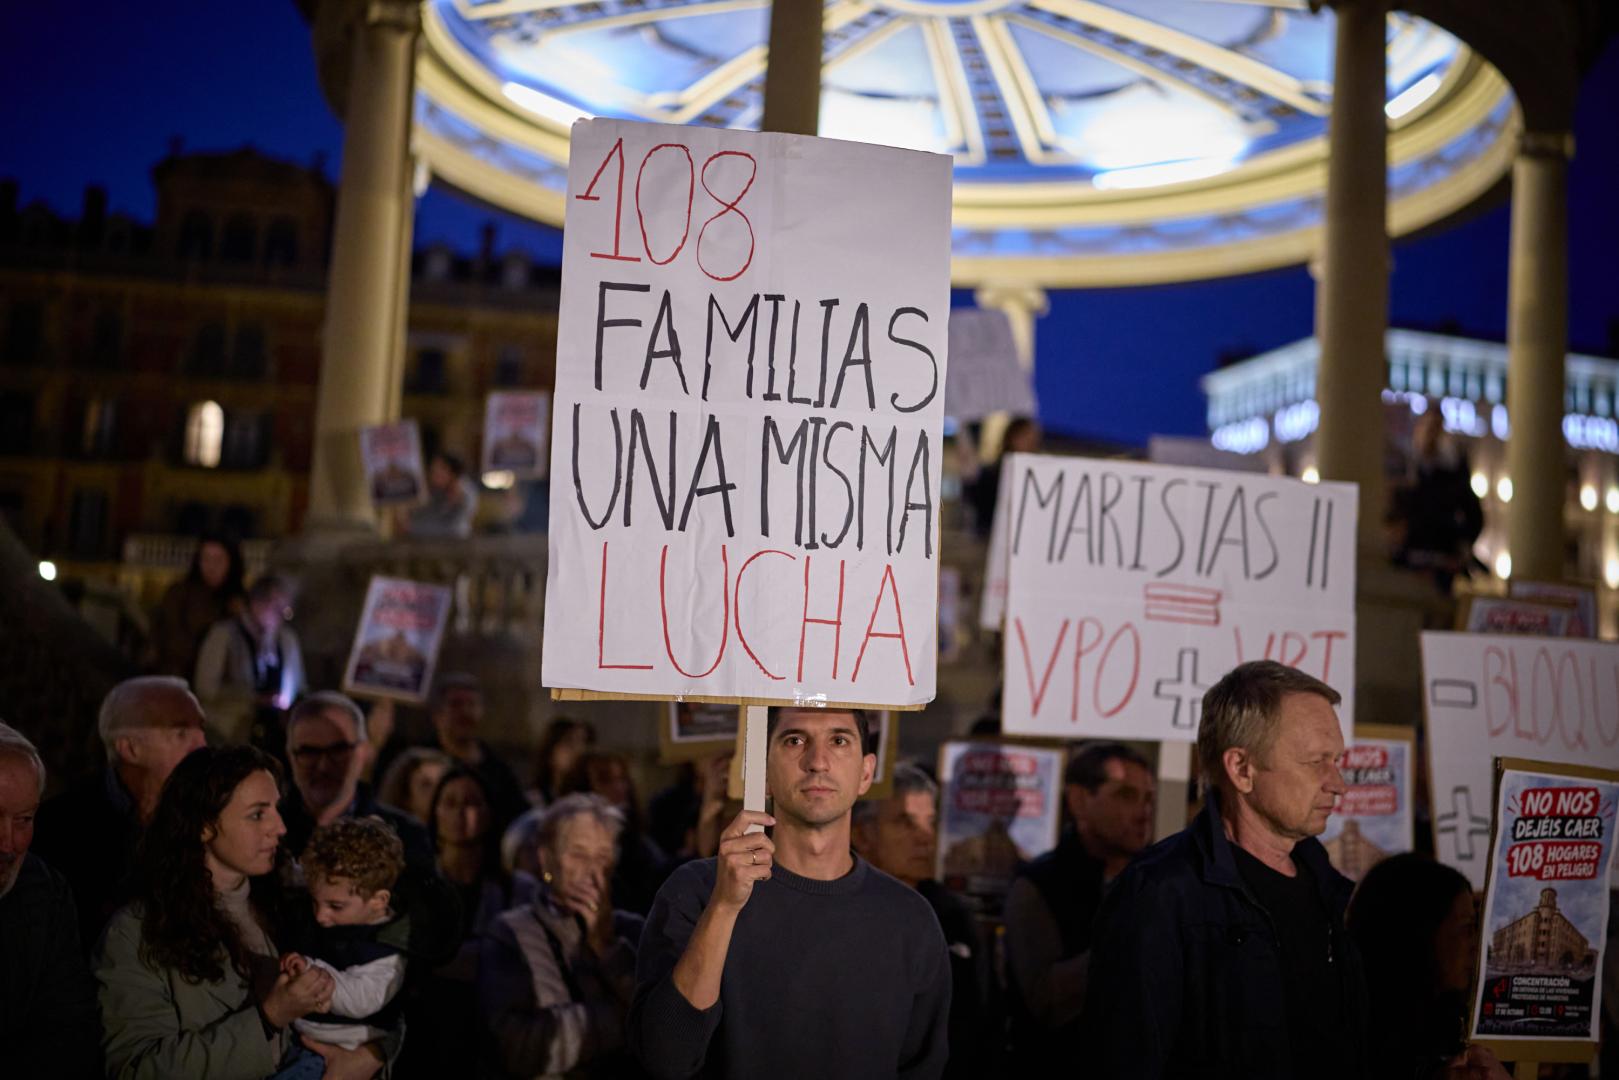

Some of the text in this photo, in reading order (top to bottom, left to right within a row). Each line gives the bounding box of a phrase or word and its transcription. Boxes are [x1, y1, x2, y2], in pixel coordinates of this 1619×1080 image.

[576, 137, 757, 282] 108
[594, 281, 938, 413] FAMILIAS
[572, 403, 933, 559] UNA MISMA
[1013, 466, 1280, 581] MARISTAS
[598, 541, 915, 687] LUCHA
[1014, 616, 1141, 723] VPO
[1515, 816, 1600, 839] DEJÉIS CAER
[1524, 790, 1597, 816] NO NOS
[1511, 843, 1599, 875] 108 HOGARES
[1542, 862, 1594, 880] EN PELIGRO
